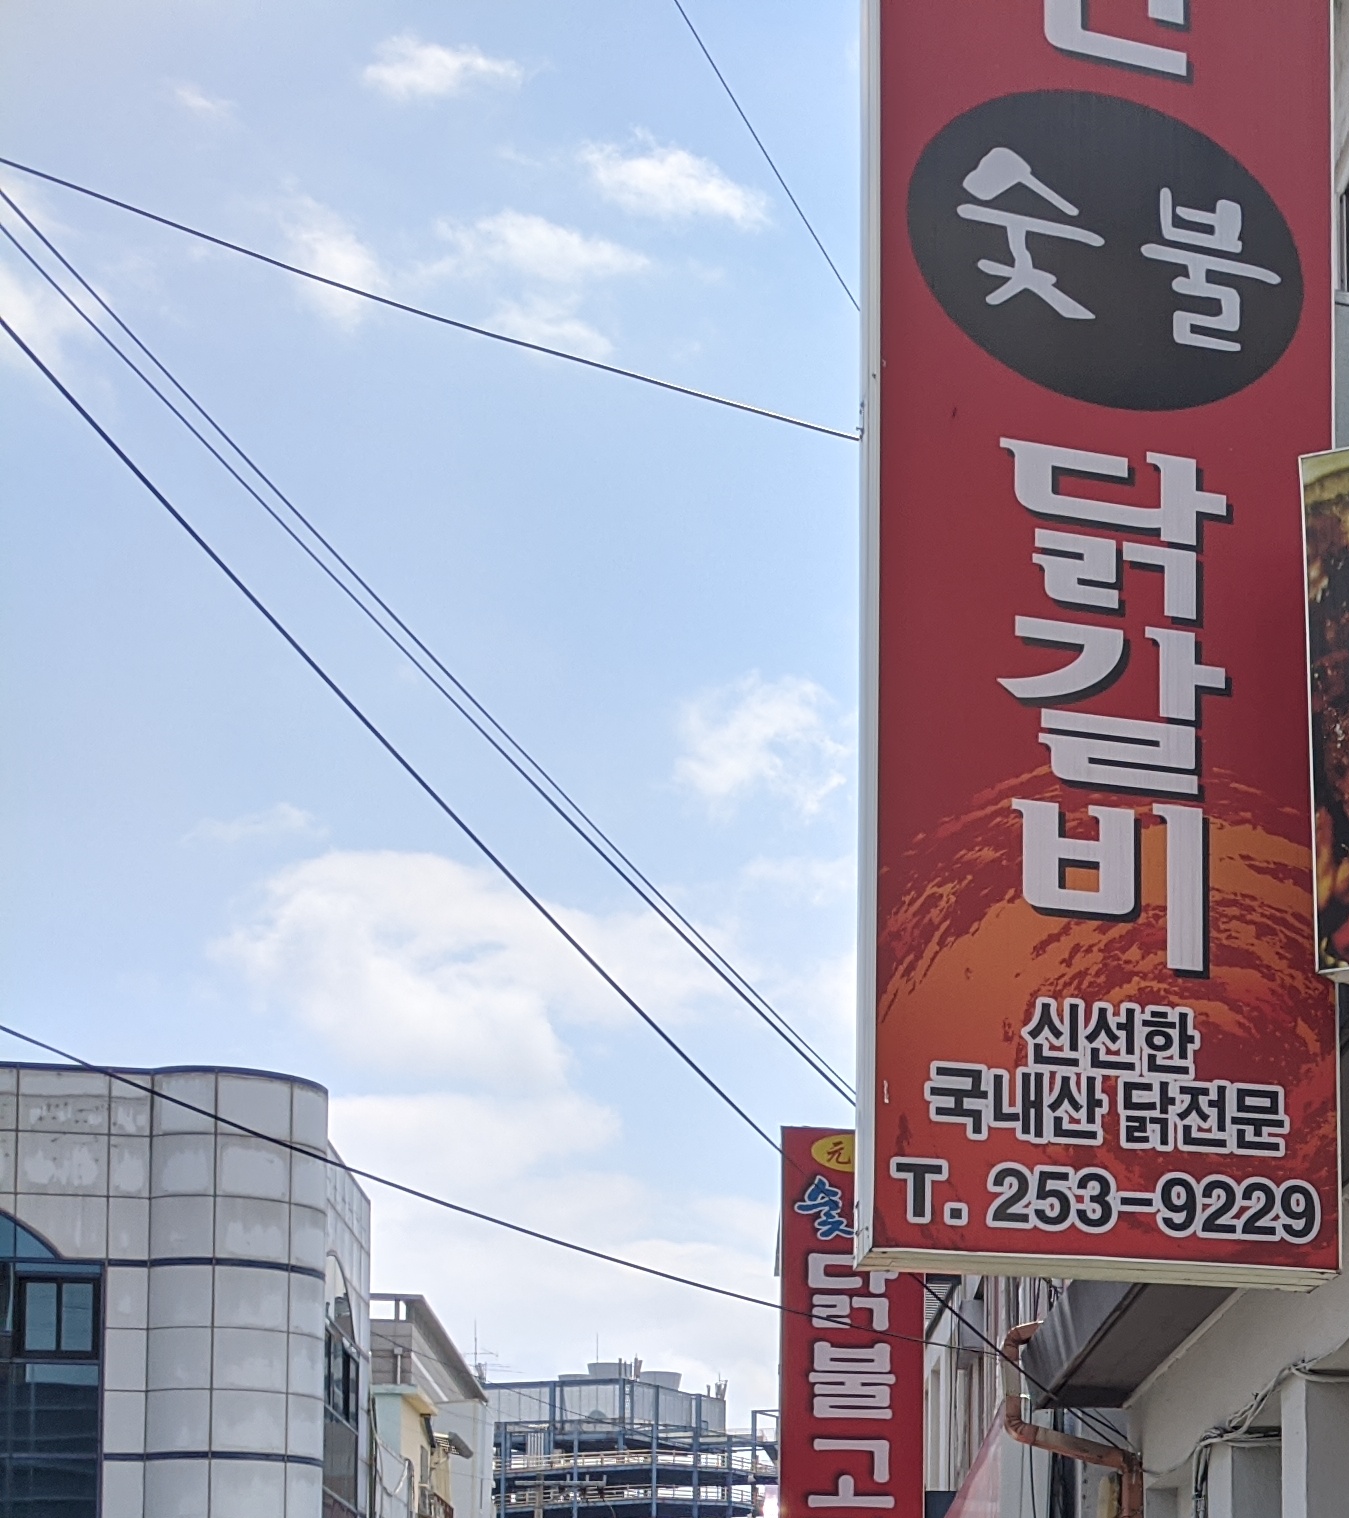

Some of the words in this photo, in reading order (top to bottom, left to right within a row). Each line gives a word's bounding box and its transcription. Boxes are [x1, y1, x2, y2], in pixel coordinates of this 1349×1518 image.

[956, 146, 1283, 352] 숯불
[996, 436, 1227, 974] 닭갈비
[1024, 997, 1202, 1079] 신선한
[925, 1060, 1104, 1145] 국내산
[1115, 1071, 1290, 1158] 닭전문
[889, 1156, 970, 1226] T.
[988, 1160, 1322, 1244] 253-9229
